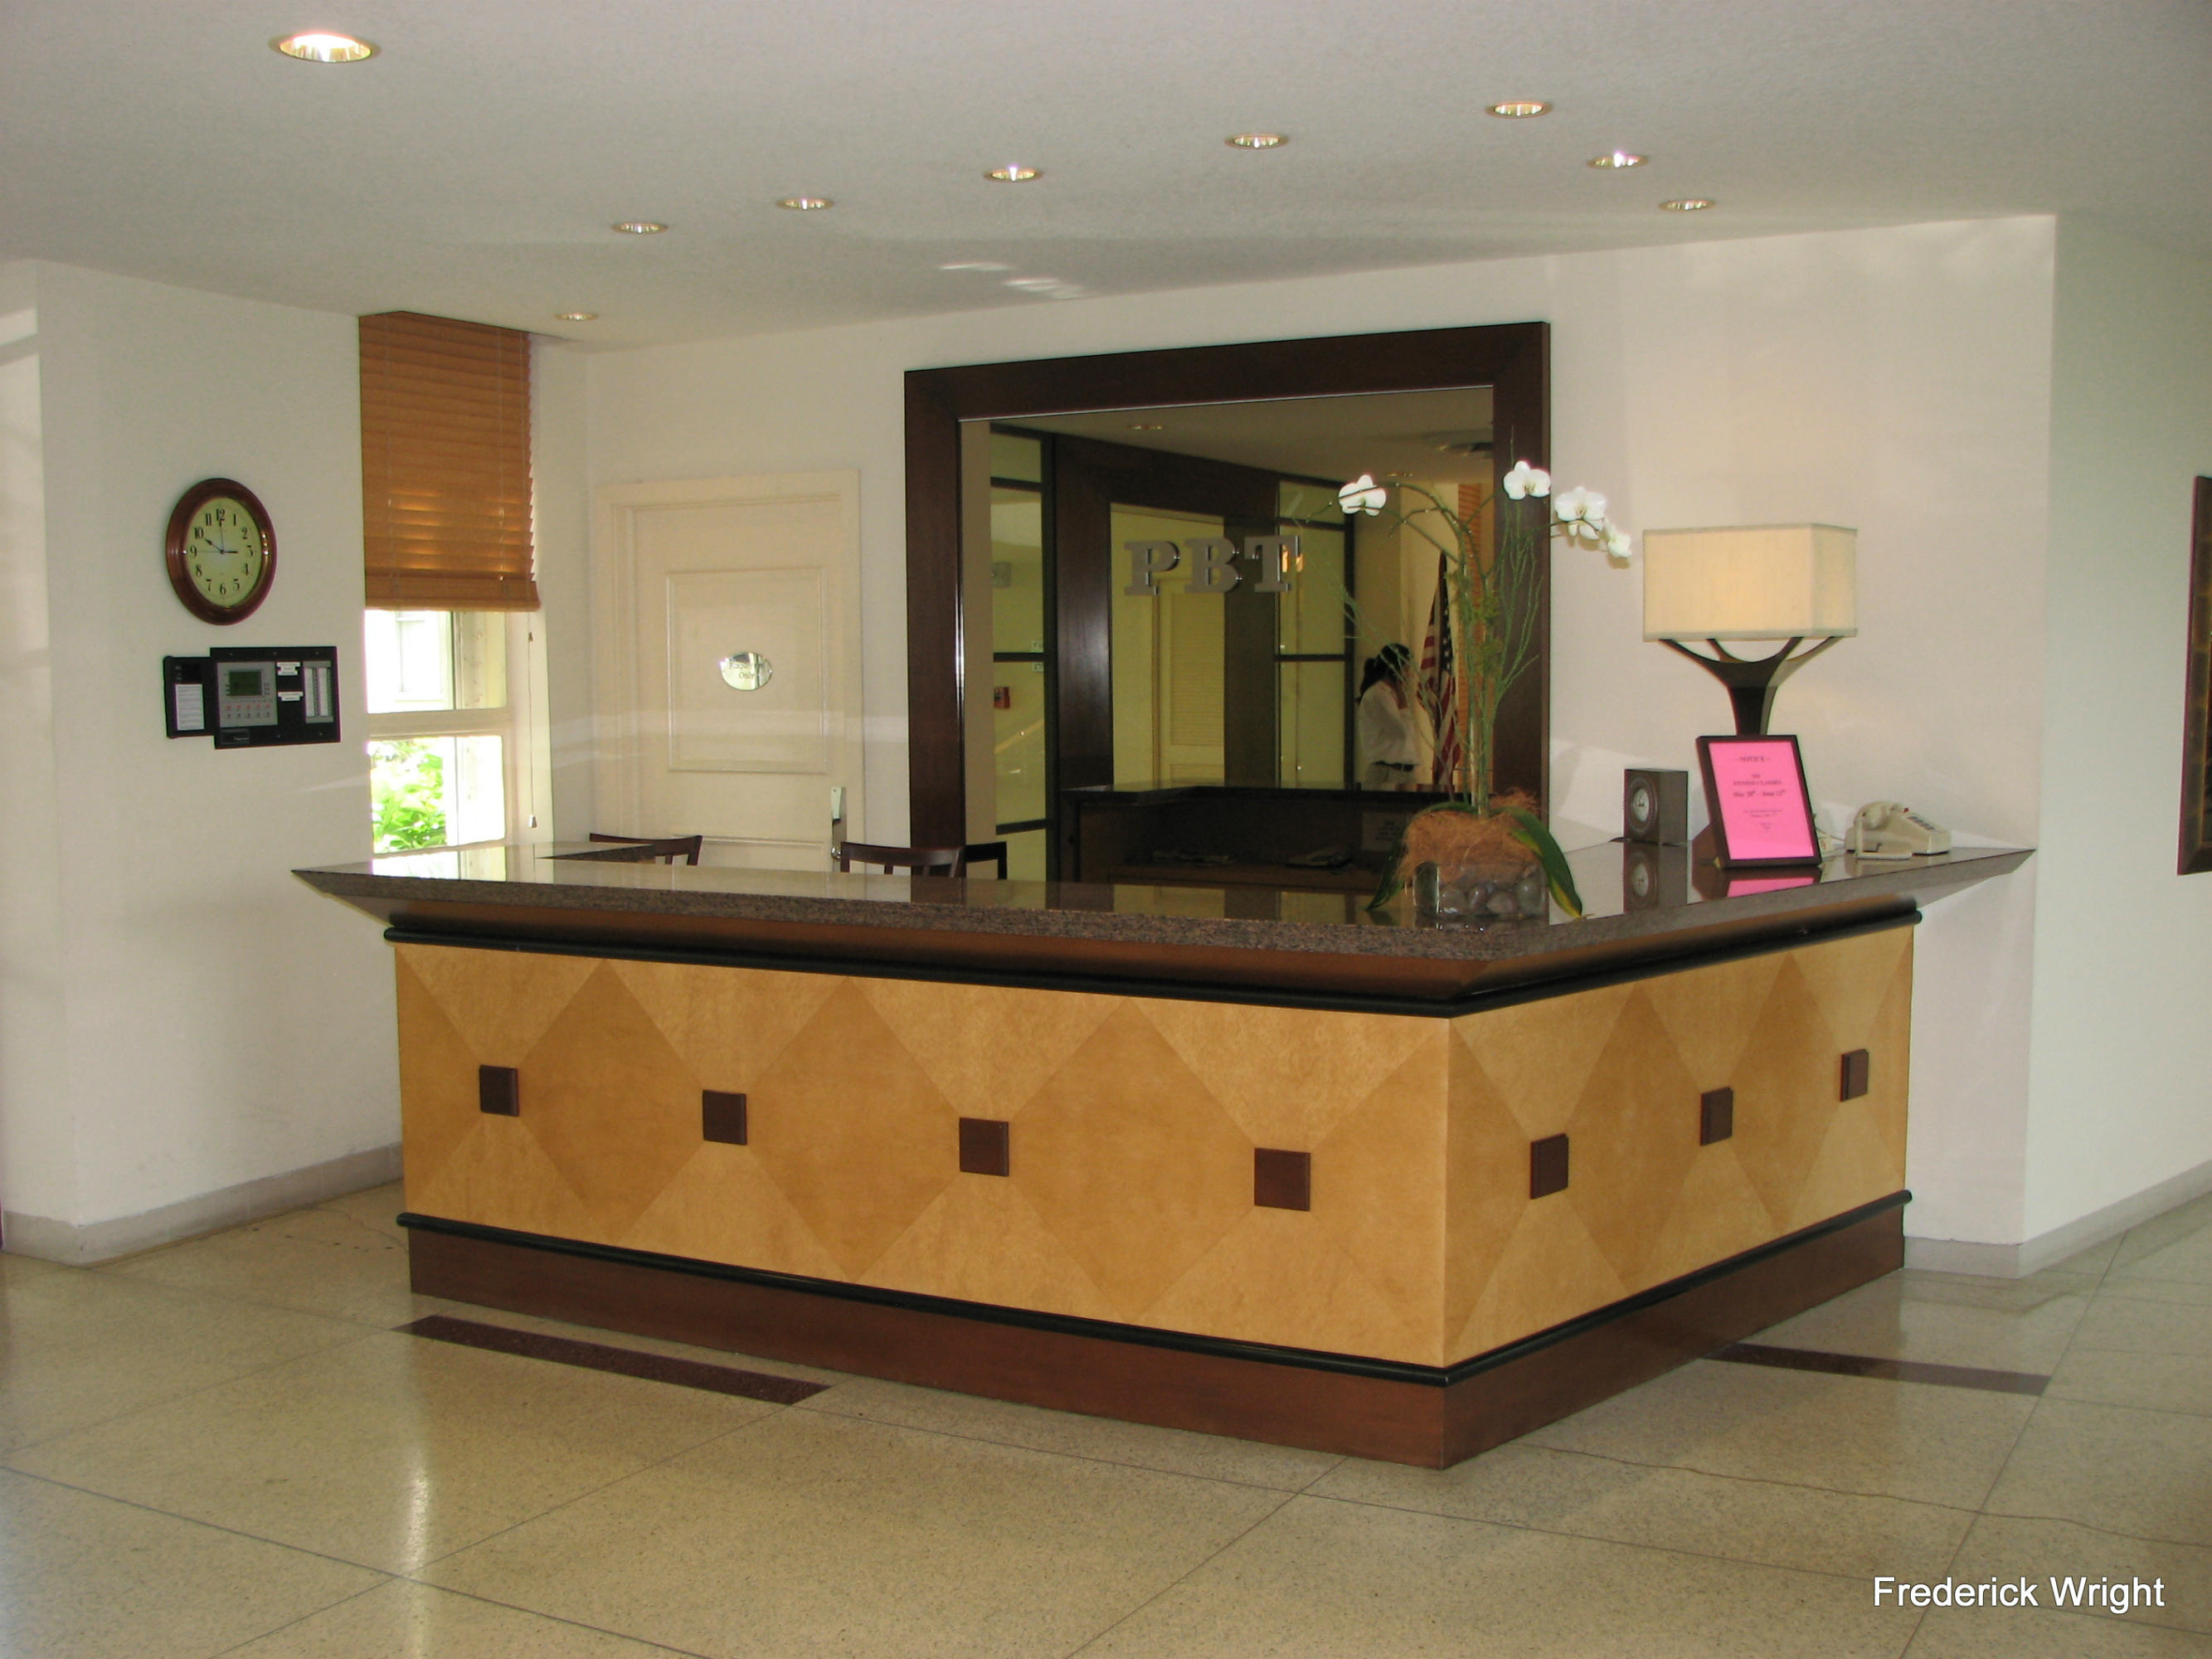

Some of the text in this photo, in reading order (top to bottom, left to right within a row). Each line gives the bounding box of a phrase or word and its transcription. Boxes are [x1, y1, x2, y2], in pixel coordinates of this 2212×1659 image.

[205, 513, 211, 526] 11
[216, 508, 226, 521] 12
[233, 513, 237, 526] 1
[194, 528, 204, 539] 10
[241, 528, 248, 539] 2
[190, 546, 197, 557] 9
[196, 565, 202, 577] 8
[241, 563, 249, 576] 4
[1124, 535, 1301, 596] PBT
[206, 579, 211, 591] 7
[220, 583, 226, 596] 6
[234, 578, 240, 591] 5
